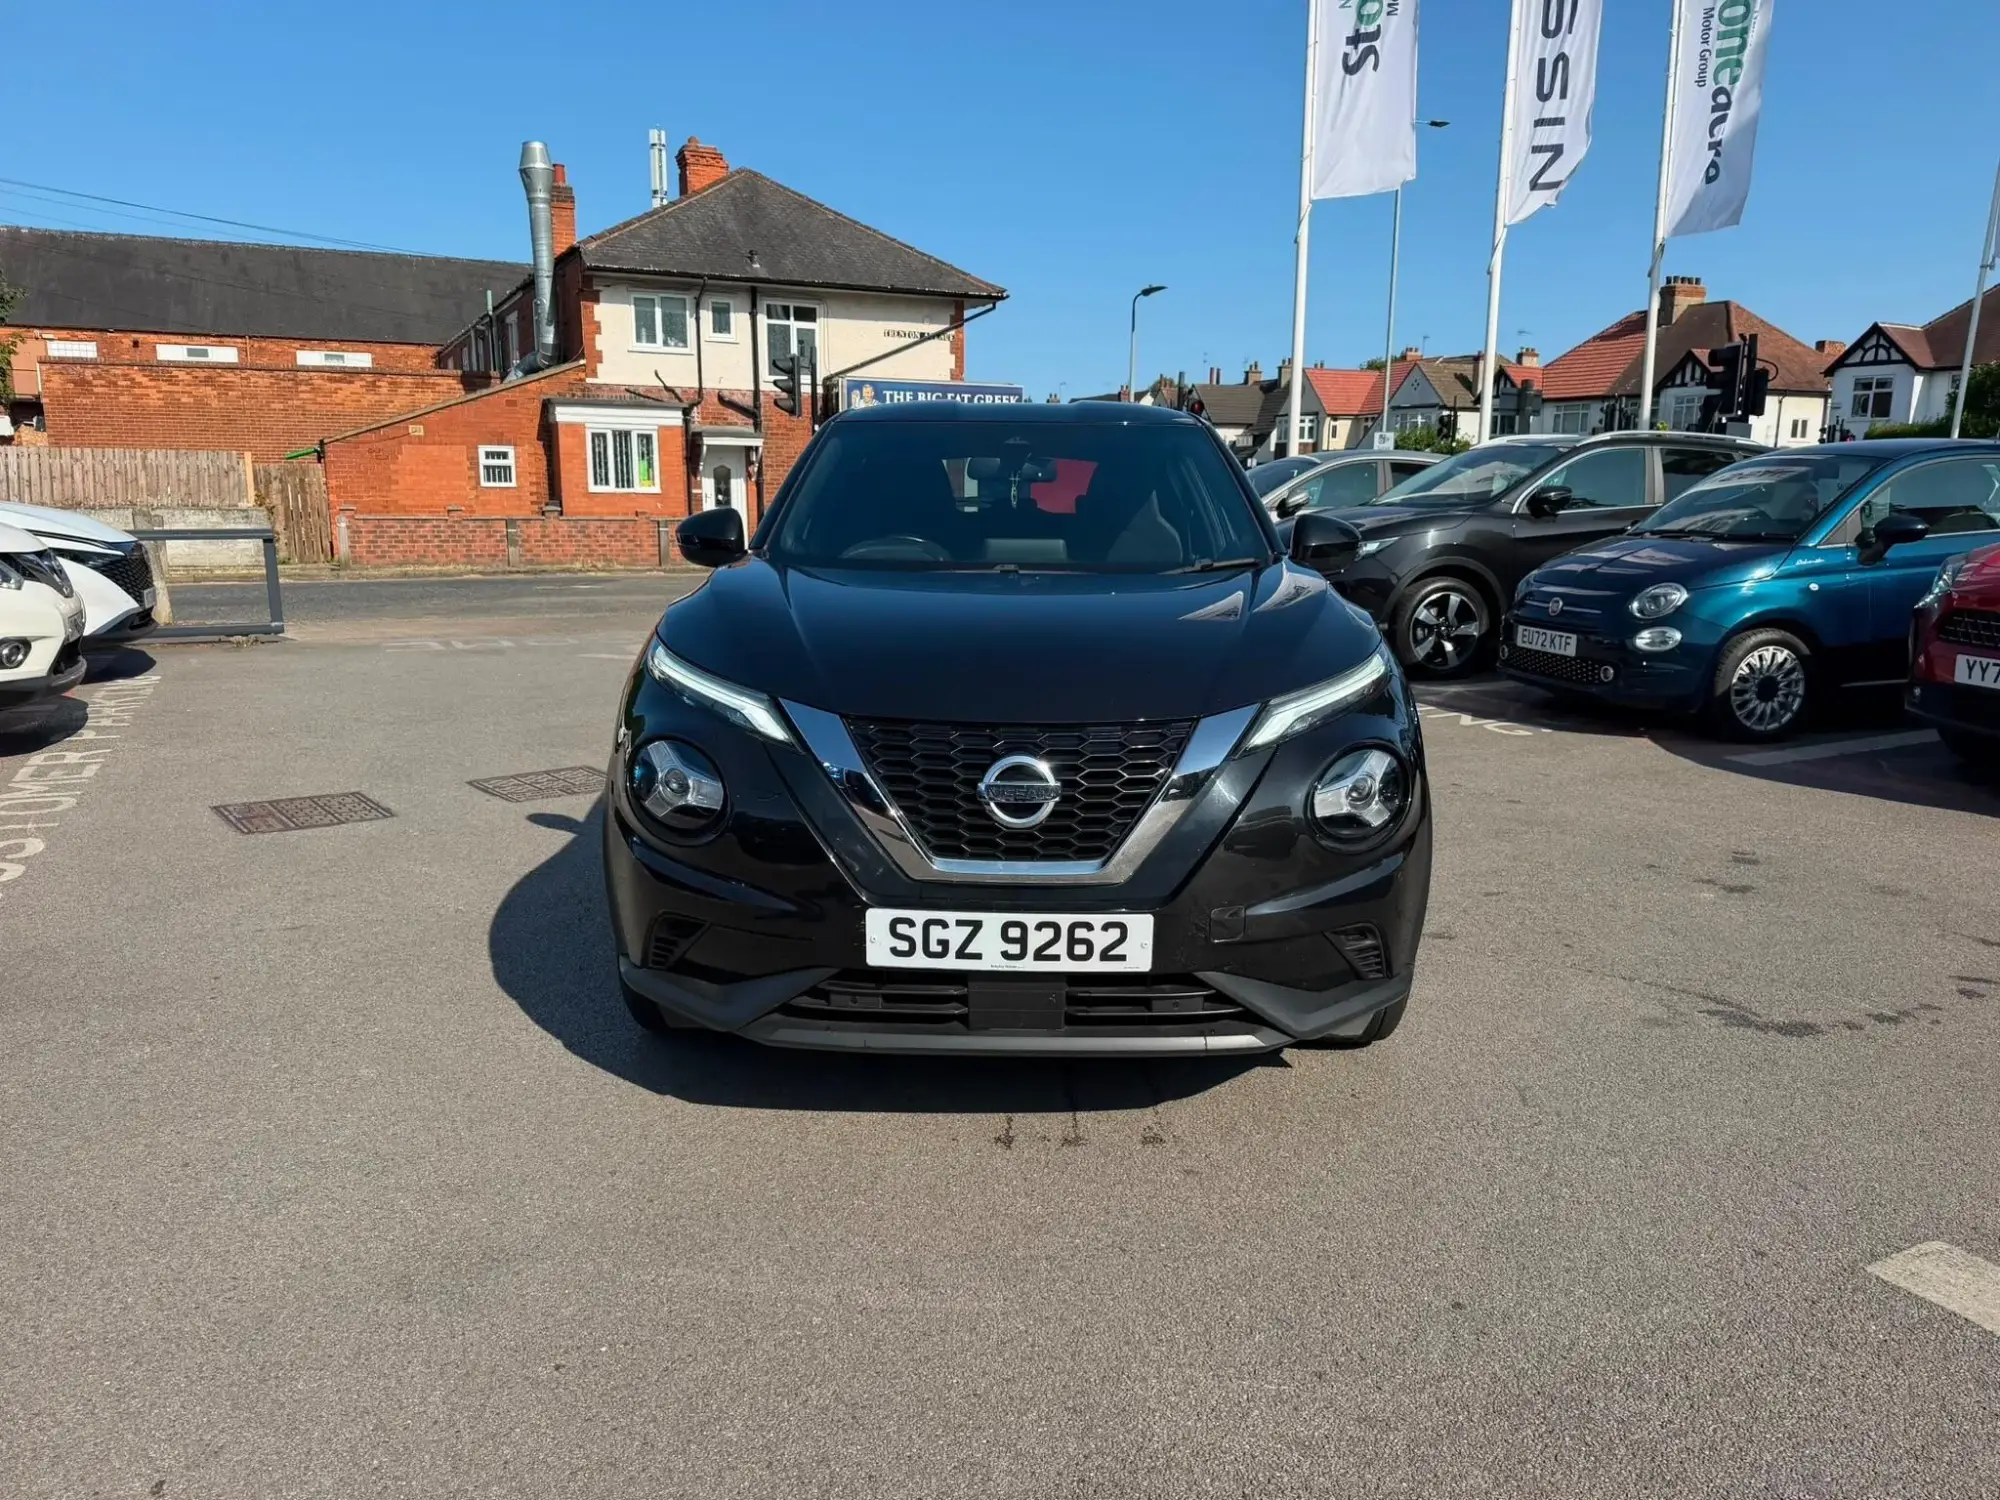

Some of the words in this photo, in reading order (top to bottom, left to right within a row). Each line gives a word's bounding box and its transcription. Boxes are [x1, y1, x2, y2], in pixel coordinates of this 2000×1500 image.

[1700, 6, 1715, 46] Motor
[1694, 47, 1711, 88] Group
[883, 390, 914, 404] THE
[1522, 628, 1548, 648] EU72
[1549, 632, 1572, 652] KTF
[1966, 658, 2000, 683] YY7
[888, 916, 984, 961] SGZ
[1000, 920, 1129, 963] 9262
